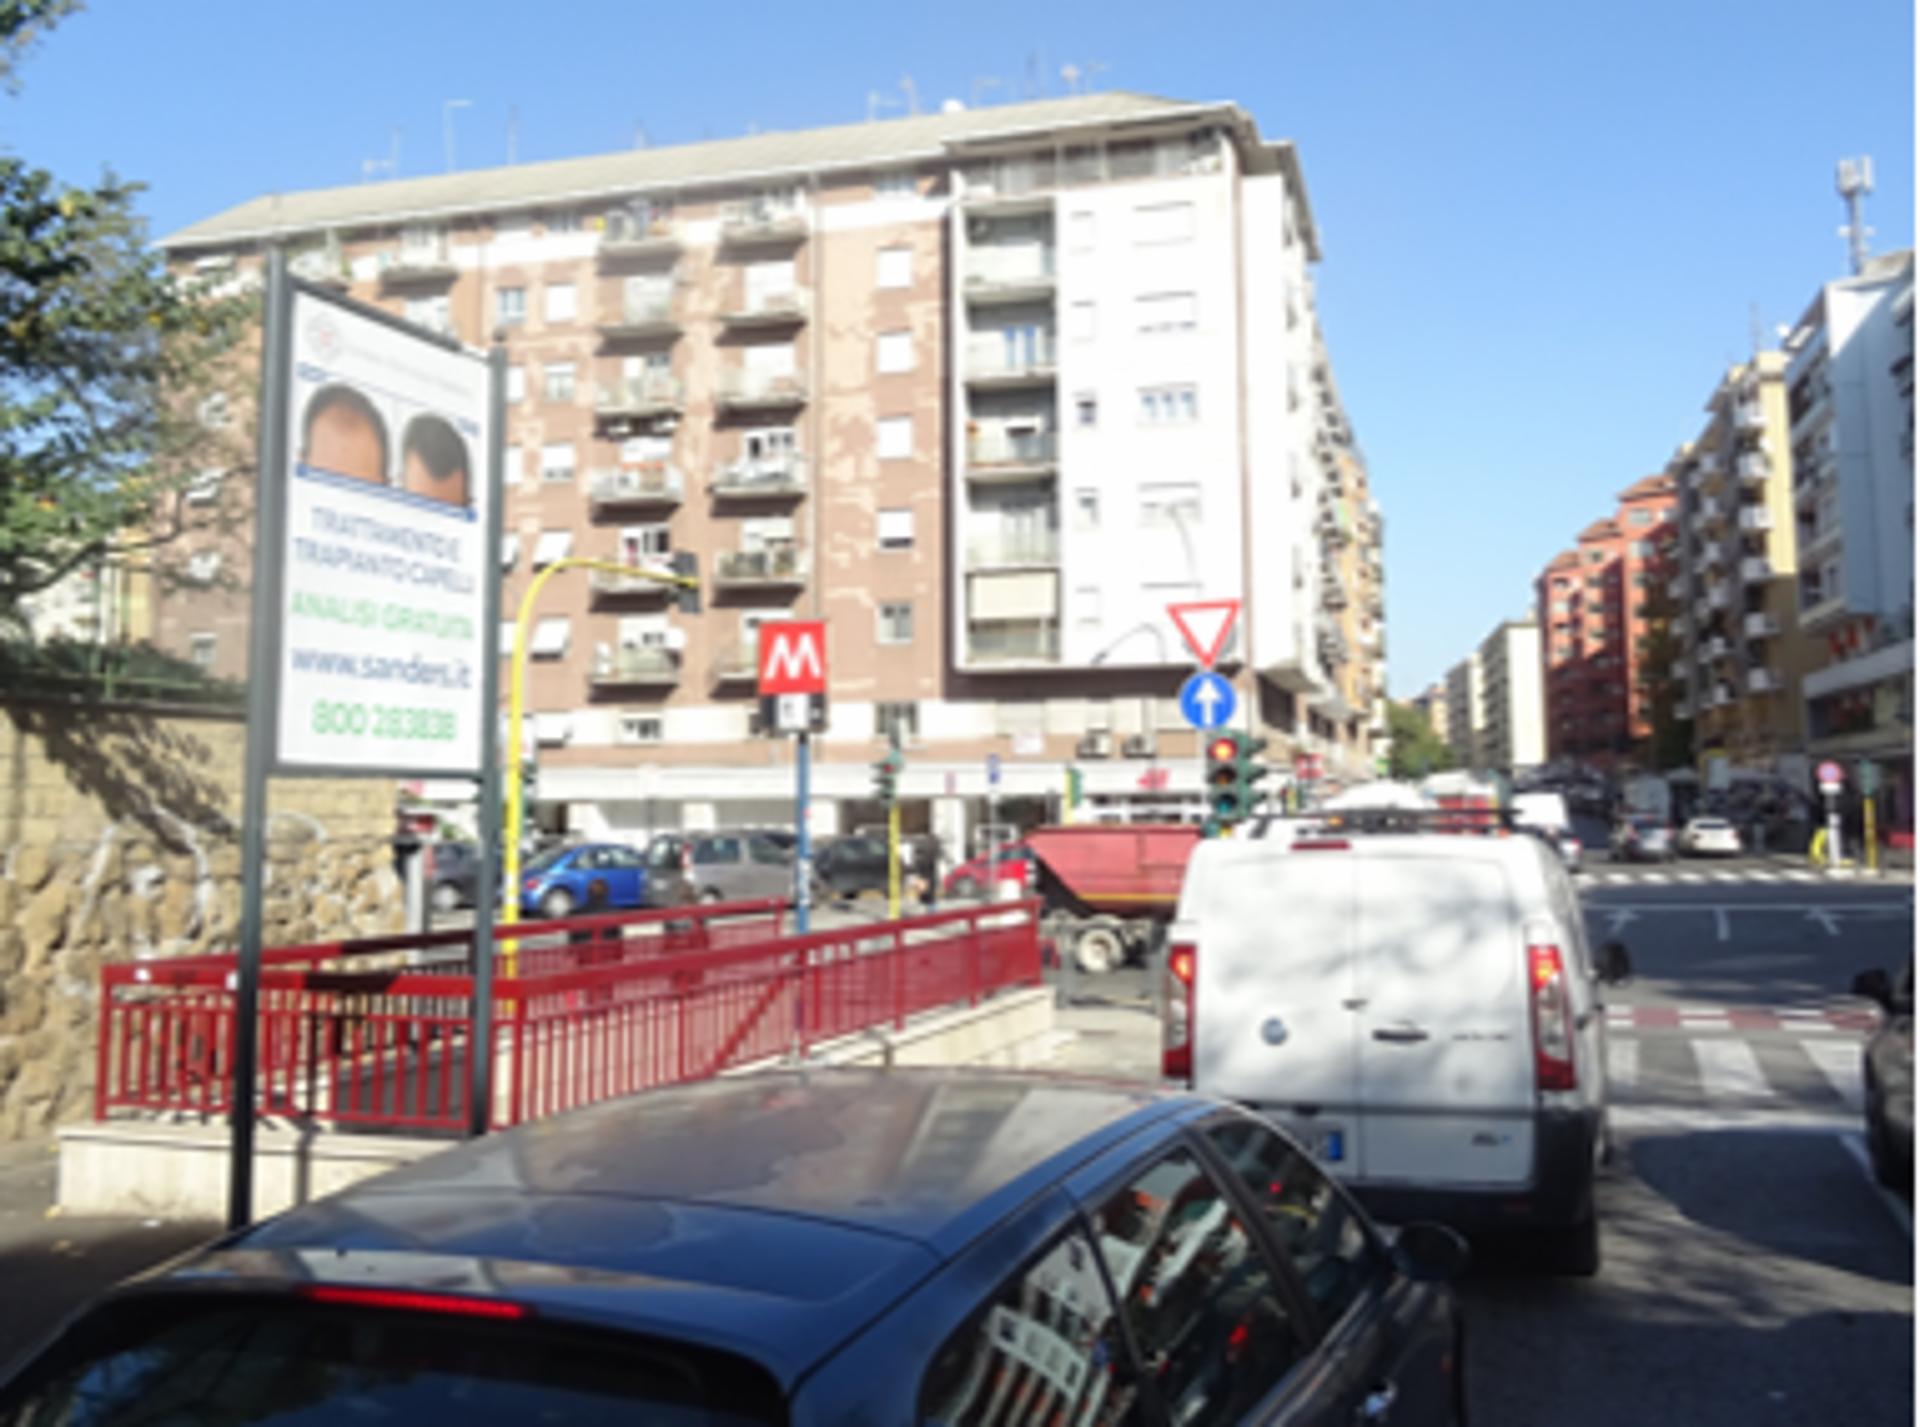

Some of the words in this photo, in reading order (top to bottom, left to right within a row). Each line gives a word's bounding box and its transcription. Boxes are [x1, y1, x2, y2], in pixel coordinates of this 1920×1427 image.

[310, 505, 446, 560] TRATTAMENTO
[293, 537, 405, 583] TRAPIANTO
[409, 560, 475, 595] CAPELLI
[290, 591, 378, 629] ANALISI
[382, 602, 475, 640] GRATUITA
[291, 647, 473, 690] www.sanders.it
[763, 631, 821, 679] M
[311, 697, 369, 737] 800
